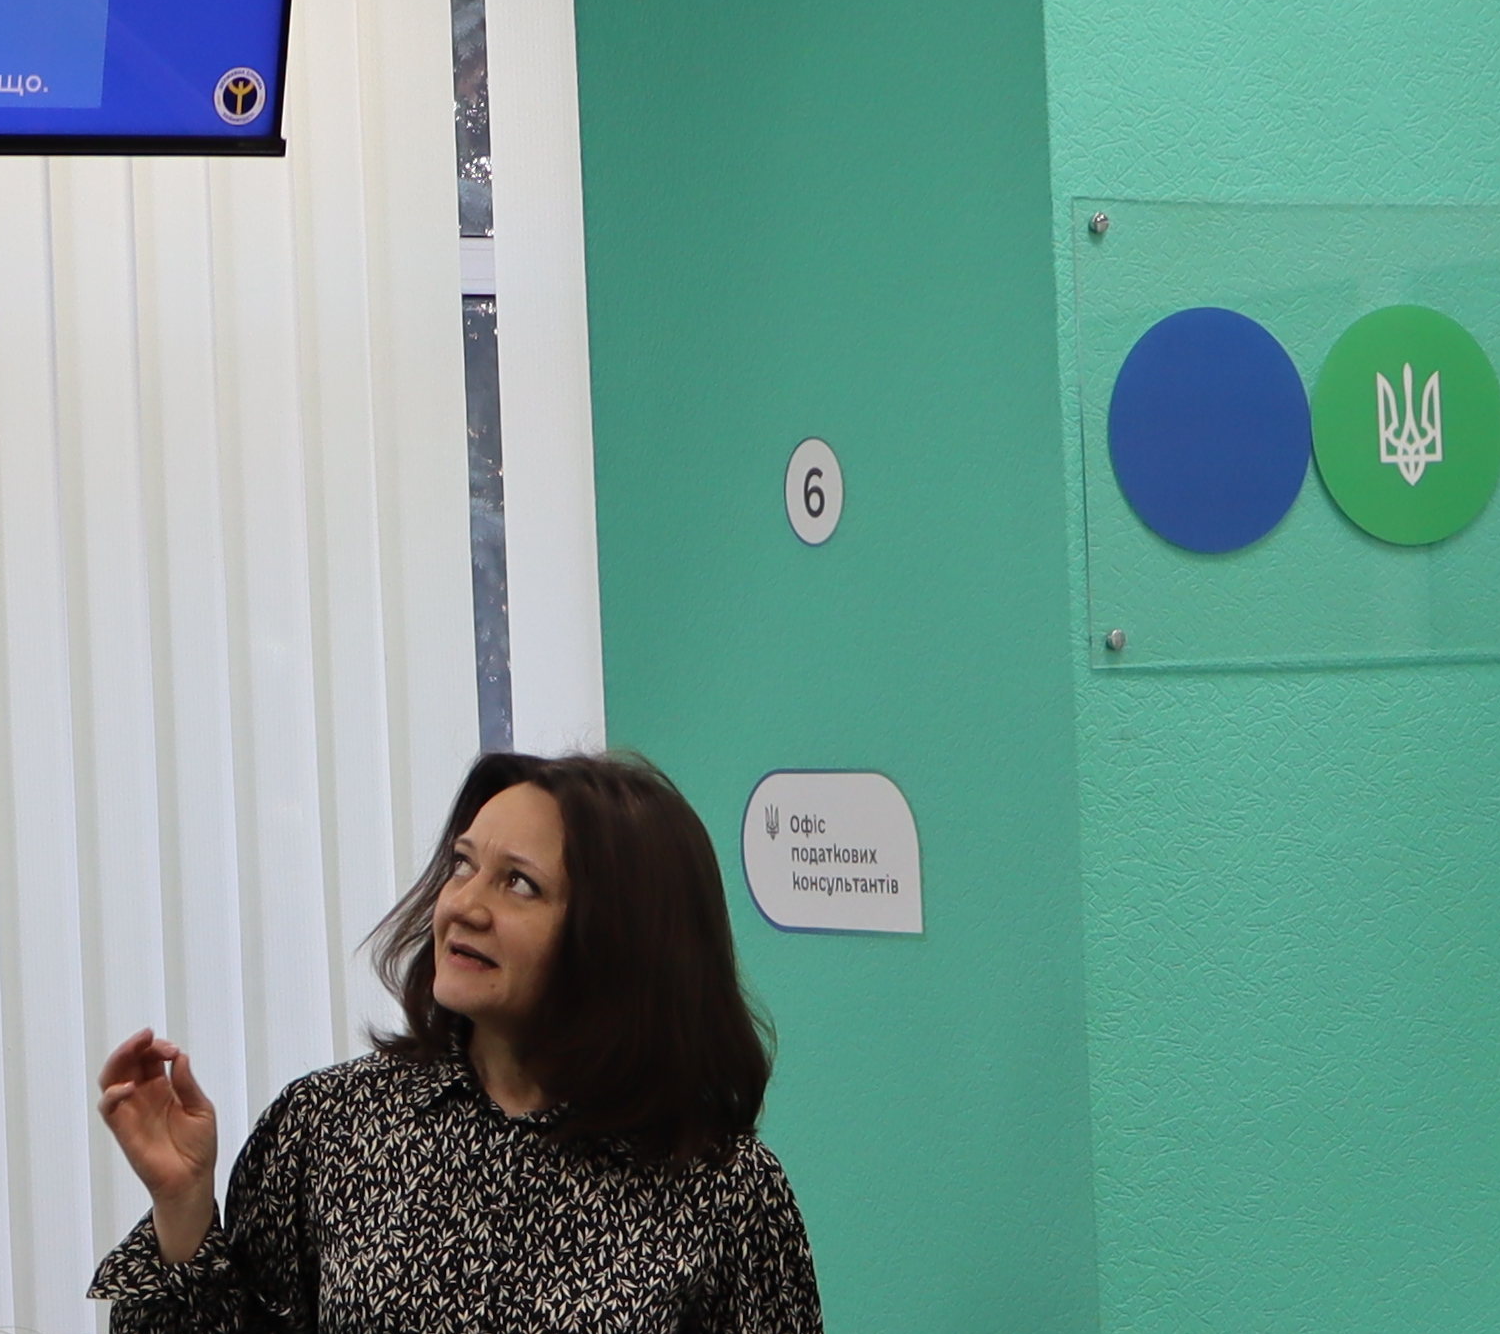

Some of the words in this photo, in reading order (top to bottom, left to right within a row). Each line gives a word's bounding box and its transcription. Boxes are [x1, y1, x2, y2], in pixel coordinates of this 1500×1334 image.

[804, 468, 825, 518] 6
[790, 815, 825, 837] Офіс
[792, 844, 877, 865] податкових
[793, 872, 898, 896] консультантів
